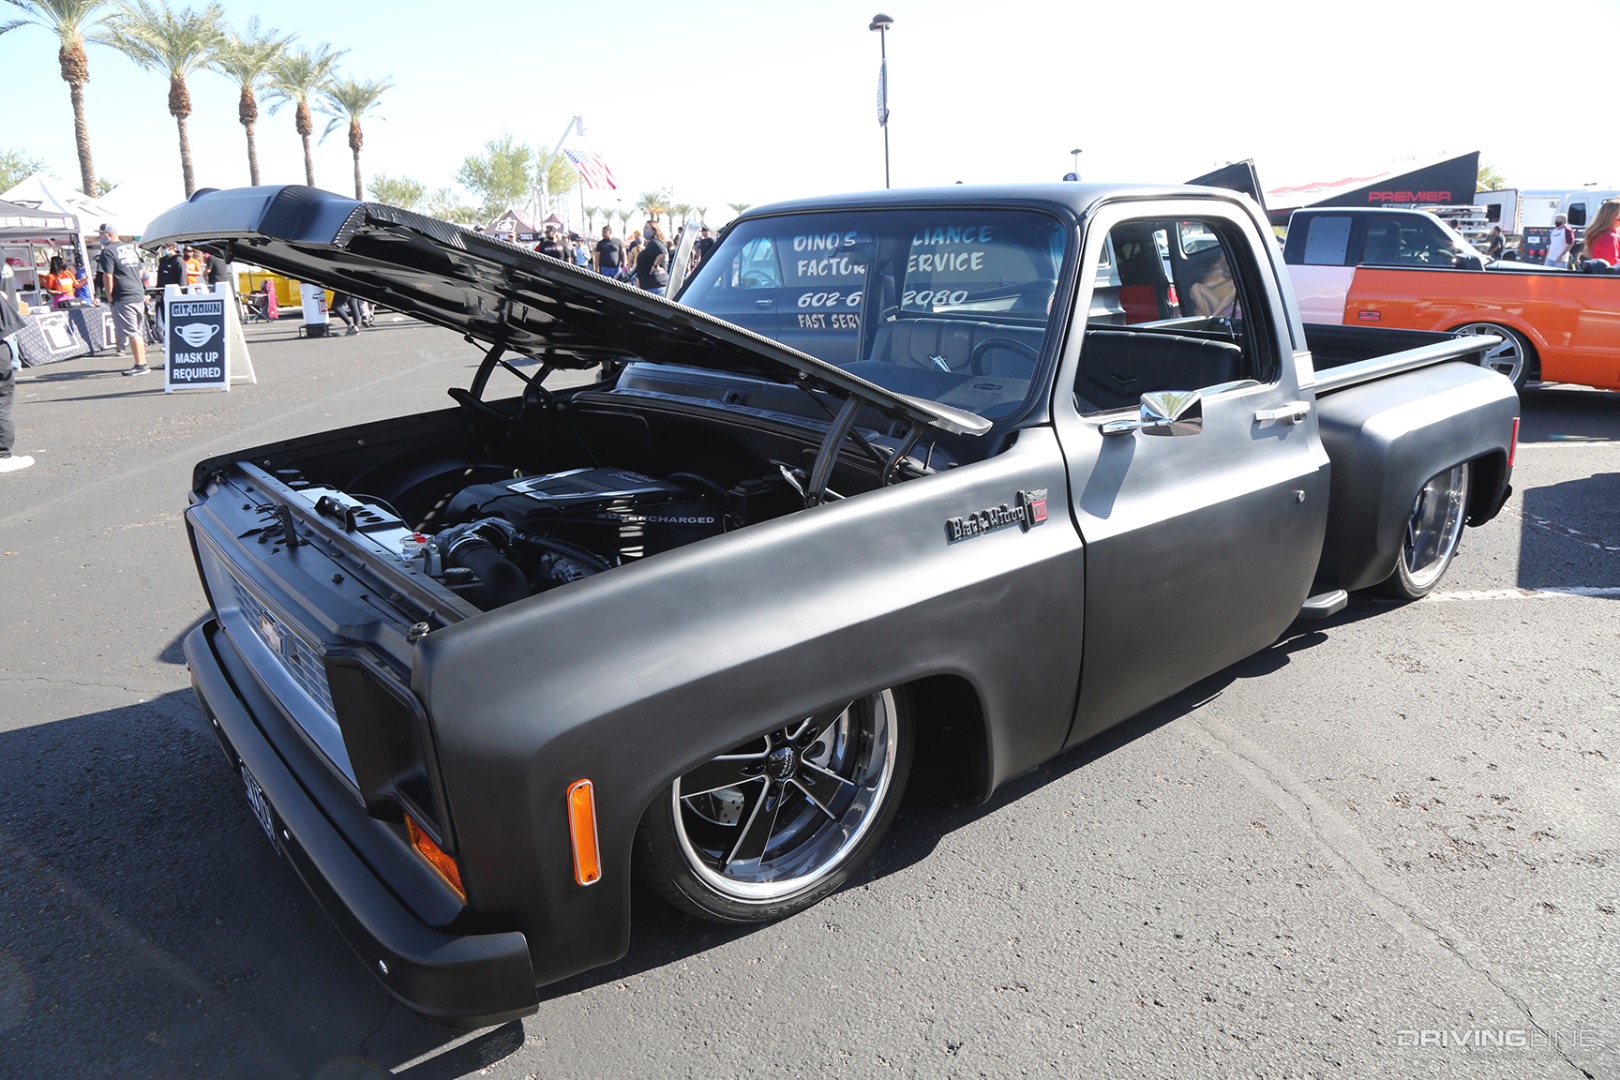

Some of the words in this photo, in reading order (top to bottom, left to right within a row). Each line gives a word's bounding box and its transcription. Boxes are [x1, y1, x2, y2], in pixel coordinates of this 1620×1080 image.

[1368, 191, 1452, 202] PREMIER
[793, 231, 857, 252] DINO'S
[797, 313, 826, 329] FAST
[175, 352, 203, 364] MASK
[205, 351, 219, 362] UP
[173, 367, 221, 381] REQUIRED
